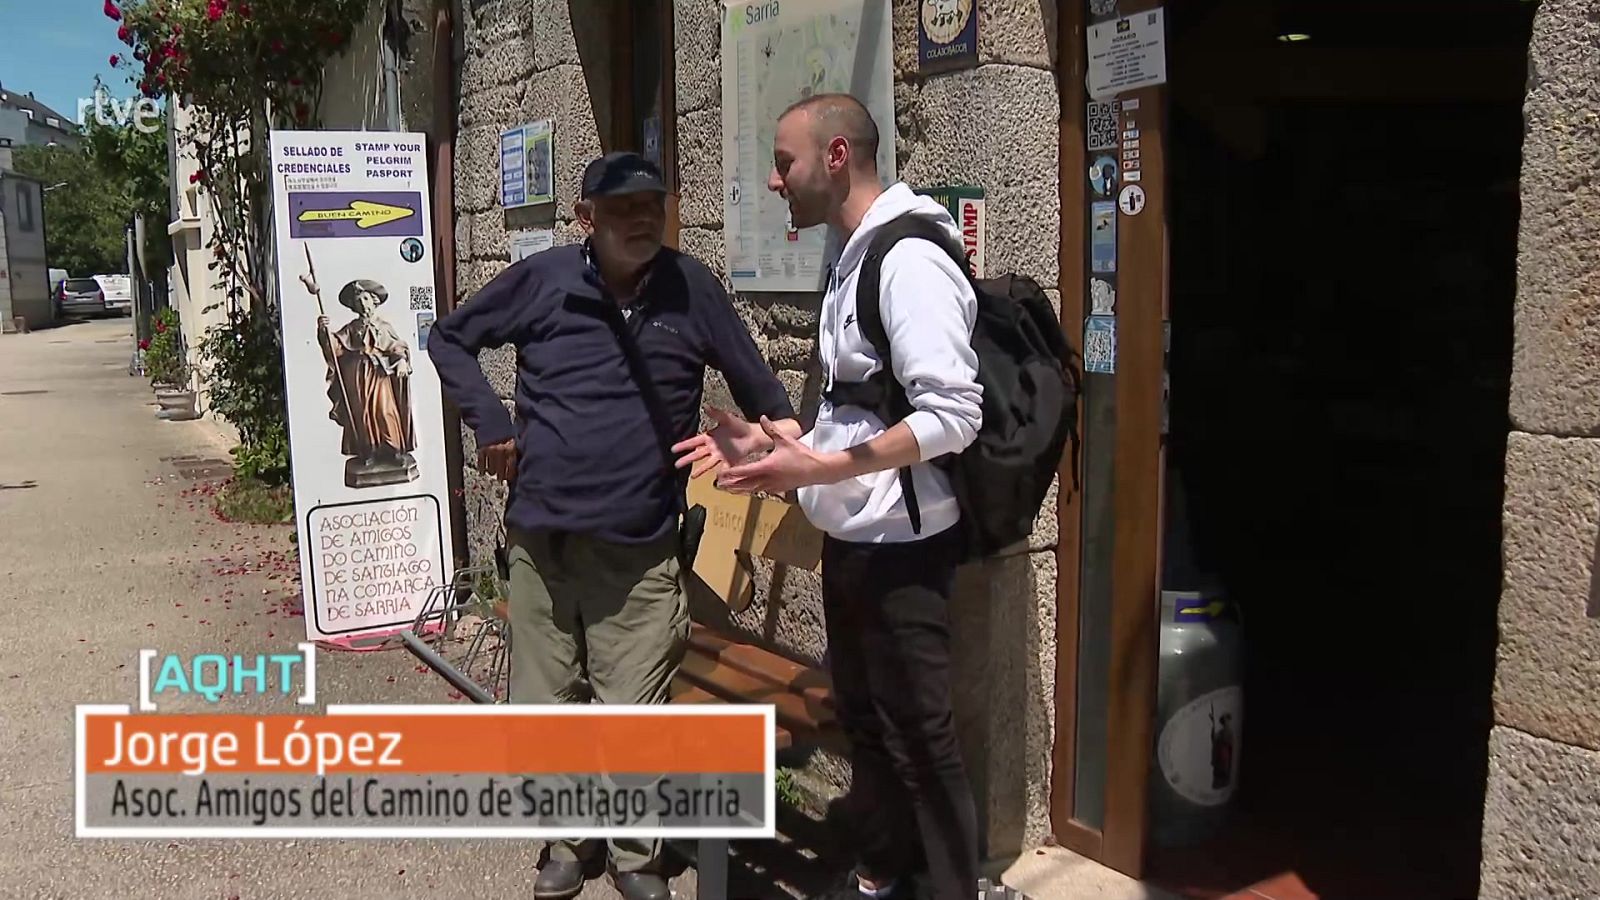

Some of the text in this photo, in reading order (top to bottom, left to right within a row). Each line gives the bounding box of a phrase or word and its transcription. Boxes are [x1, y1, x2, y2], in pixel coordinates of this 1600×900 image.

[746, 0, 779, 25] Sarria
[283, 146, 343, 157] SELLADO DE
[355, 143, 421, 152] STAMP YOUR
[277, 163, 351, 174] CREDENCIALES
[366, 156, 412, 165] PELGRIM
[366, 169, 413, 178] PASPORT
[317, 209, 392, 218] BUEN CAMINO
[963, 203, 978, 257] STAMP
[319, 505, 418, 532] ASOCIACIÓN
[321, 525, 412, 550] DE AMIGOS
[322, 543, 417, 568] DO CAMINO
[324, 559, 432, 586] DE SANTIAGO
[326, 576, 435, 603] NA COMARCA
[328, 597, 411, 622] DE SARRIA
